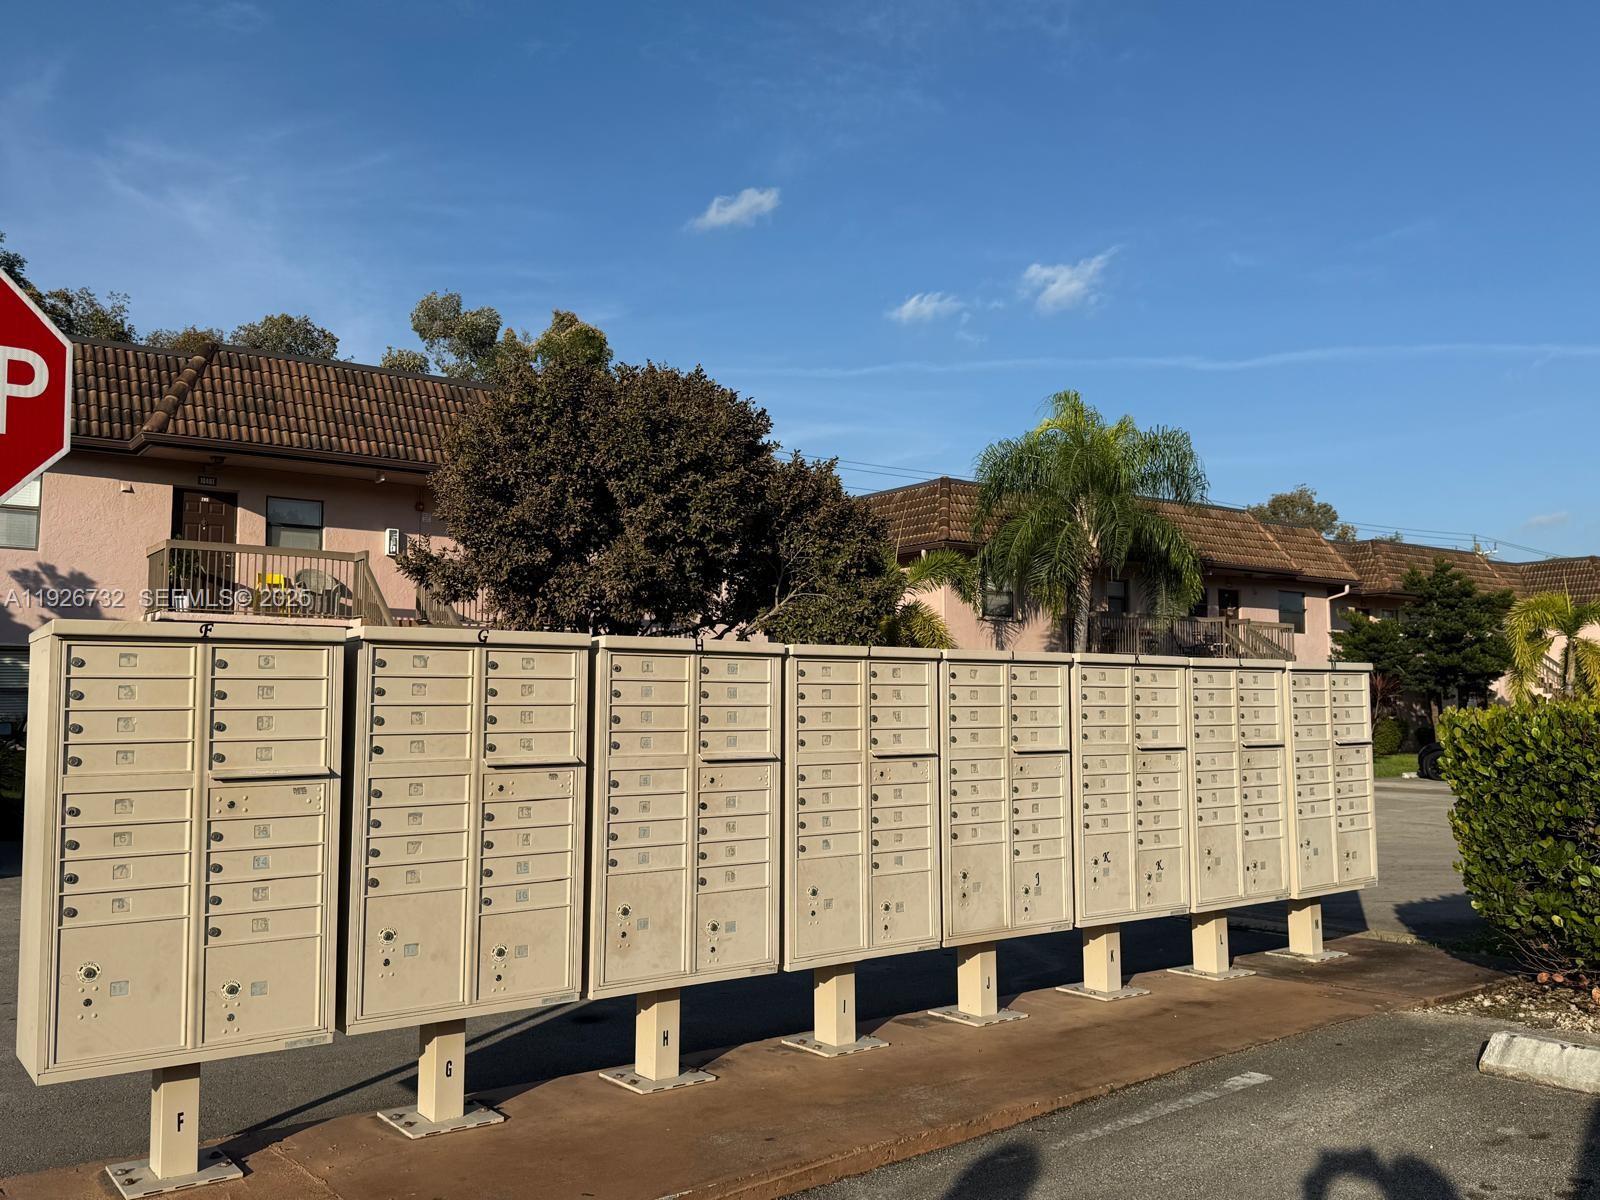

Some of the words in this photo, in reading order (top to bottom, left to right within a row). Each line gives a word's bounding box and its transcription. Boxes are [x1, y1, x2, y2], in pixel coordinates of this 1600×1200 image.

[0, 345, 50, 435] P
[199, 623, 214, 638] F
[478, 629, 490, 645] G
[695, 638, 704, 653] H
[1102, 851, 1111, 864] K
[1156, 859, 1164, 871] K
[1110, 950, 1115, 963] K
[986, 976, 990, 990] J
[662, 1030, 669, 1046] H
[445, 1060, 452, 1078] G
[176, 1112, 184, 1132] F
